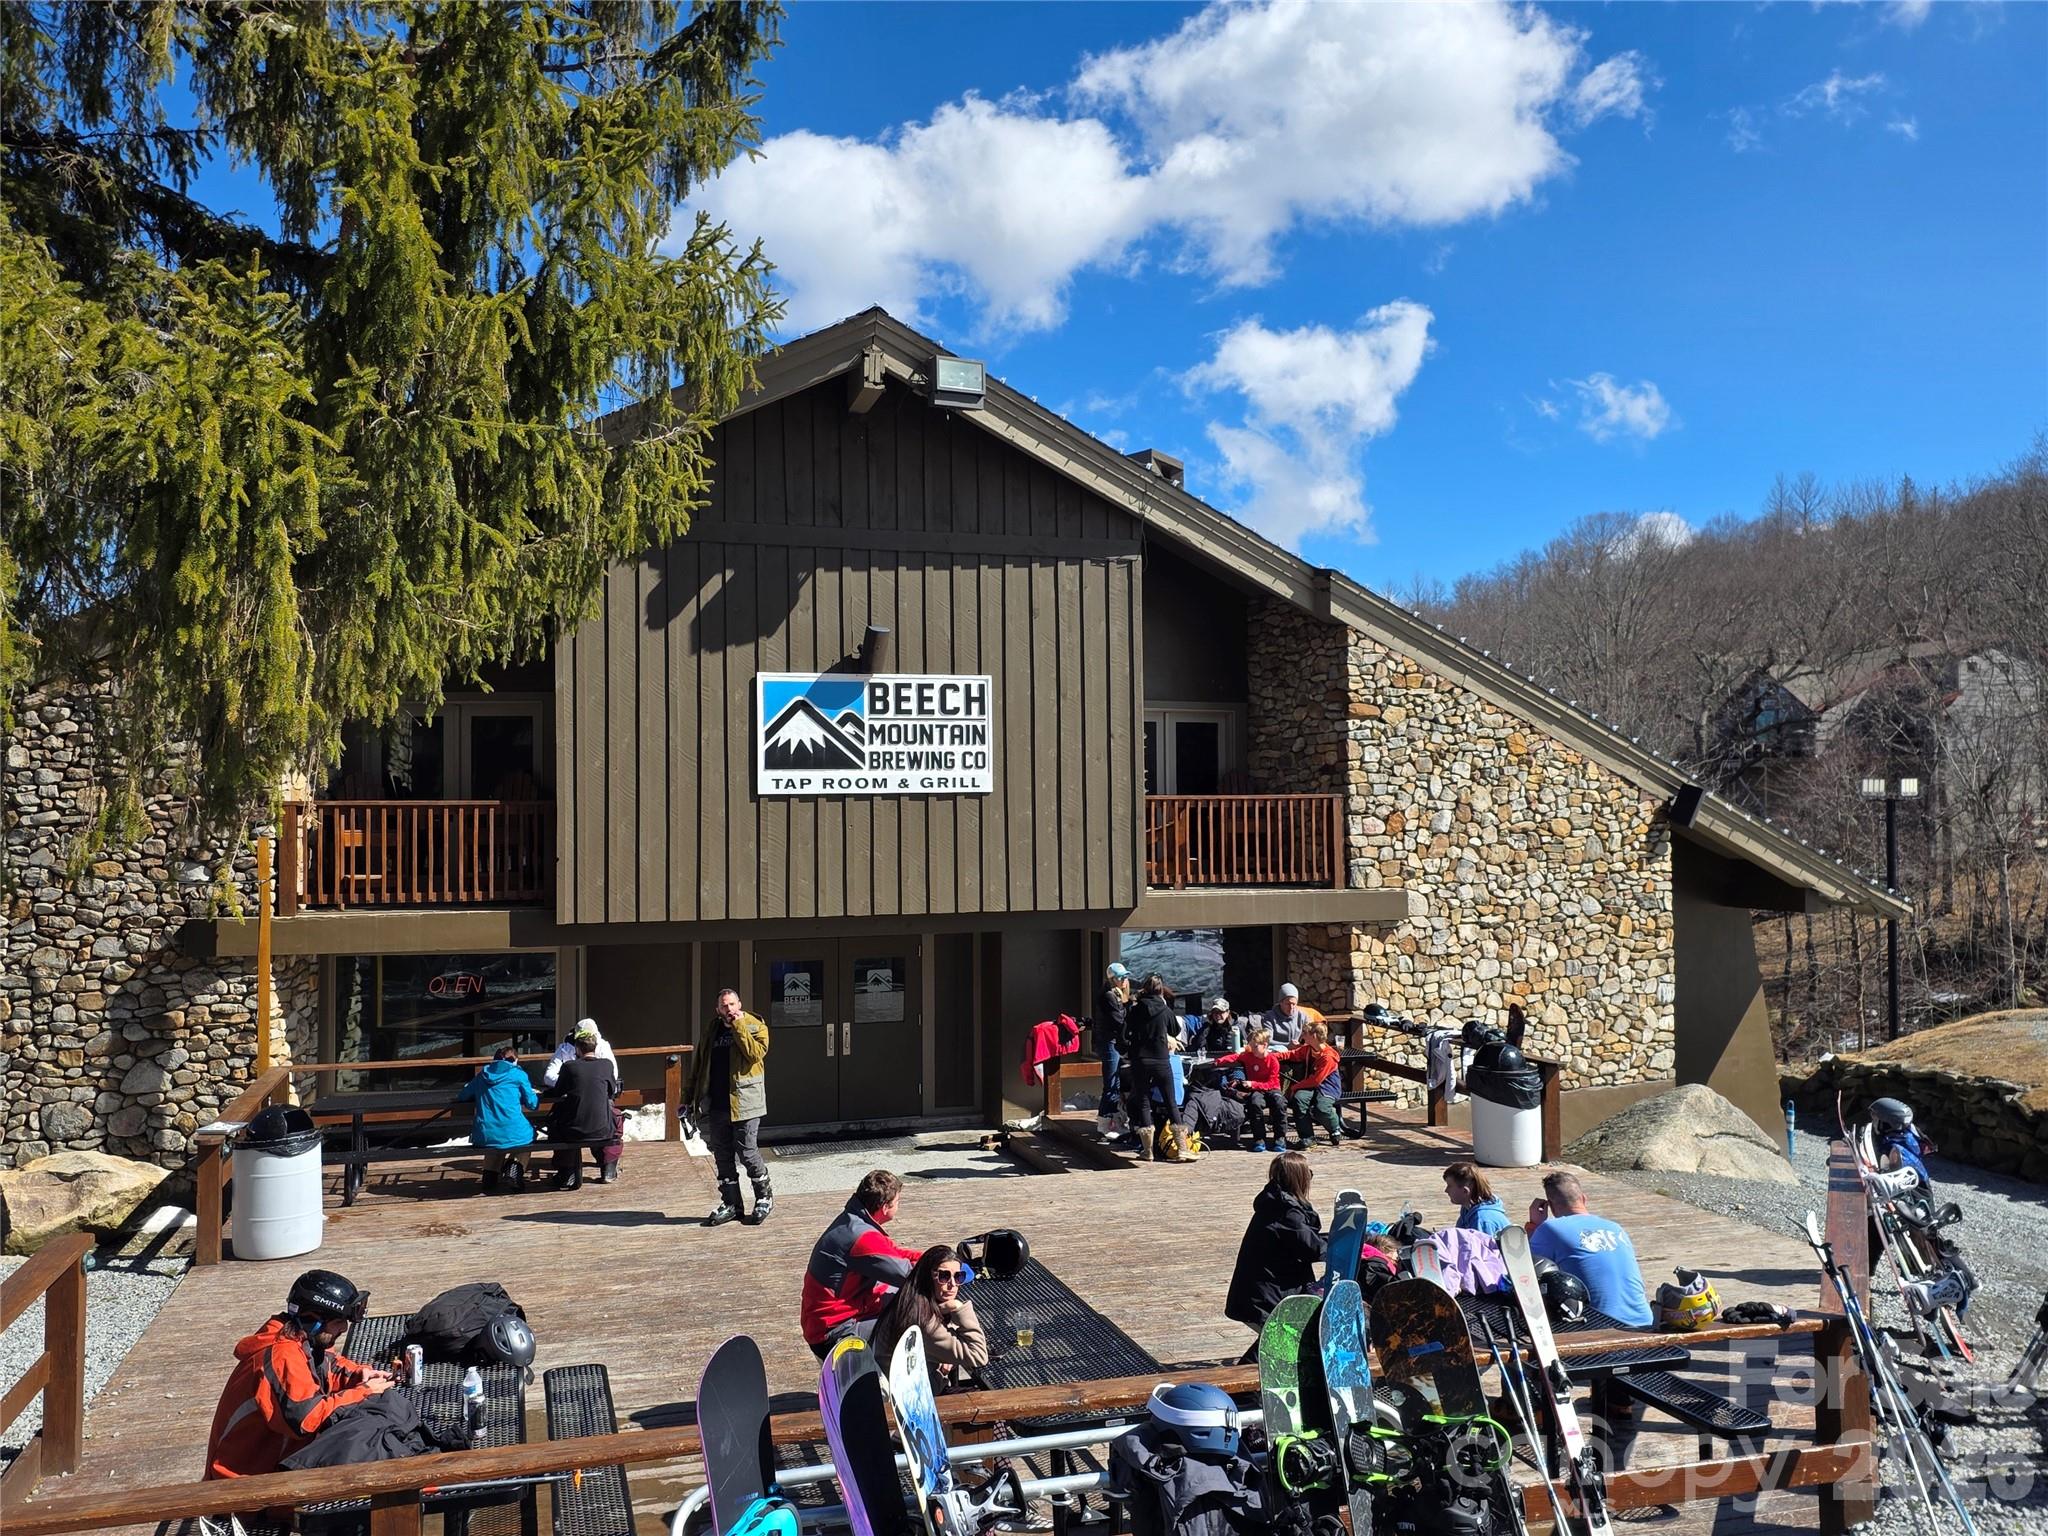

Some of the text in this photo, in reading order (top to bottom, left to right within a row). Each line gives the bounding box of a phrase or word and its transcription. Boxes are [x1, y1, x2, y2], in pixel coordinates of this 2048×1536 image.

[868, 682, 986, 716] BEECH
[868, 723, 986, 746] MOUNTAIN
[868, 750, 986, 770] BREWING CO
[772, 776, 981, 790] TAP ROOM & GRILL
[784, 996, 810, 1005] BEECH
[312, 1294, 345, 1311] SMITH
